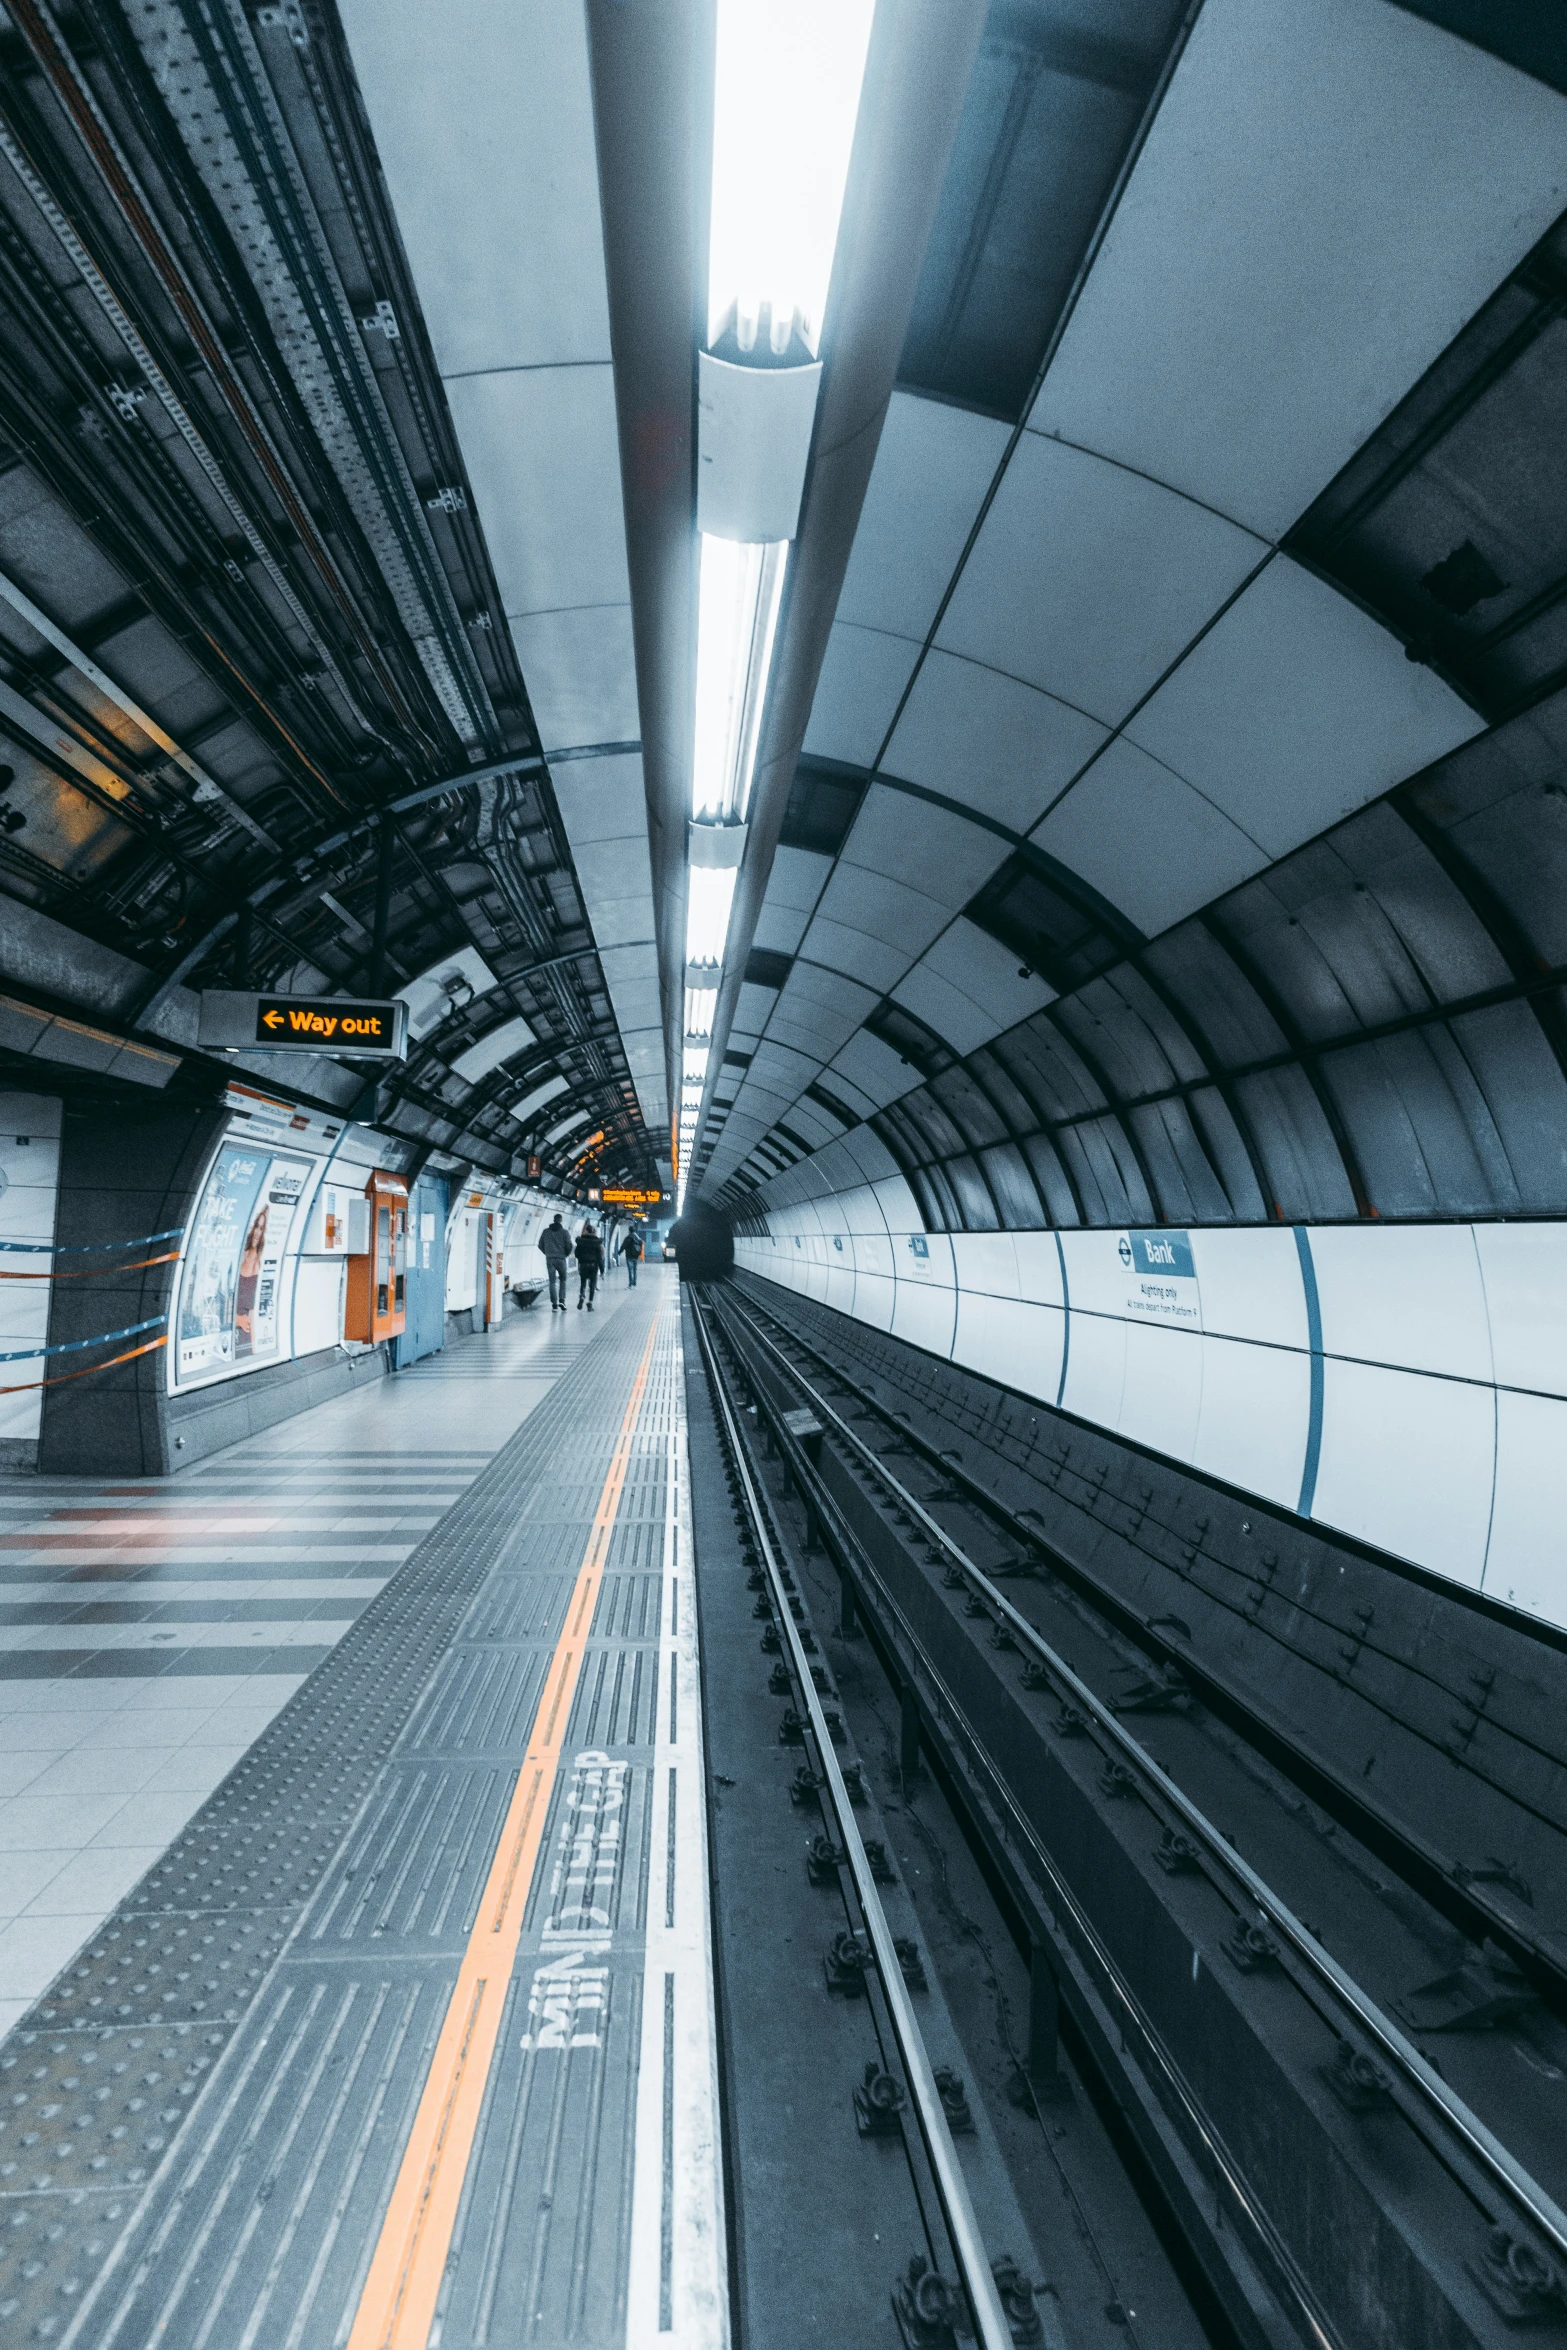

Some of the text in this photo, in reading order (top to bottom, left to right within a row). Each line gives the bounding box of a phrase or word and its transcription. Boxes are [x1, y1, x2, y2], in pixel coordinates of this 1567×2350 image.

[288, 1010, 381, 1036] Way out
[203, 1196, 238, 1221] TAKE
[194, 1224, 239, 1248] FLIGHT
[1144, 1239, 1176, 1264] Bank
[1141, 1283, 1178, 1301] Alighting only
[520, 1750, 629, 2049] MIND THE GAP
